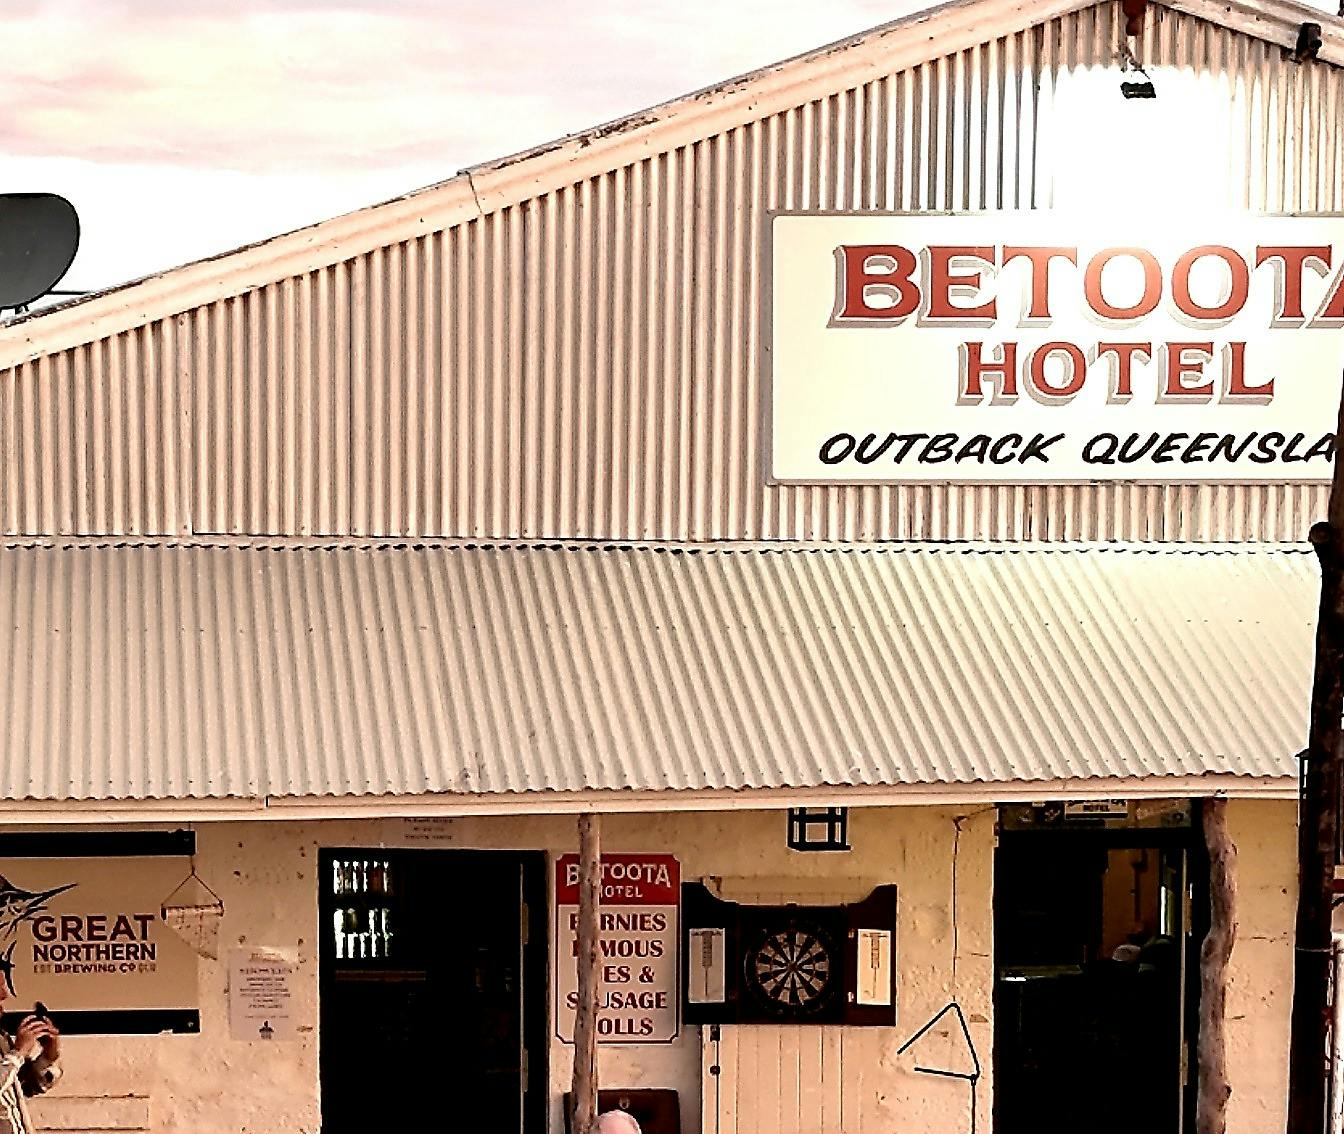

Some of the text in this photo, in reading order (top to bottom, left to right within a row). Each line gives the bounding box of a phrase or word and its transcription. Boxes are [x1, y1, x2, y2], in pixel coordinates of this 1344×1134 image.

[957, 341, 1276, 405] HOTEL
[818, 432, 1064, 465] OUTBACK
[599, 885, 643, 898] OTEL
[32, 914, 155, 942] GREAT
[33, 943, 156, 962] NORTHERN
[54, 963, 116, 974] BREWING
[638, 965, 655, 983] &
[597, 1017, 653, 1036] OLLS
